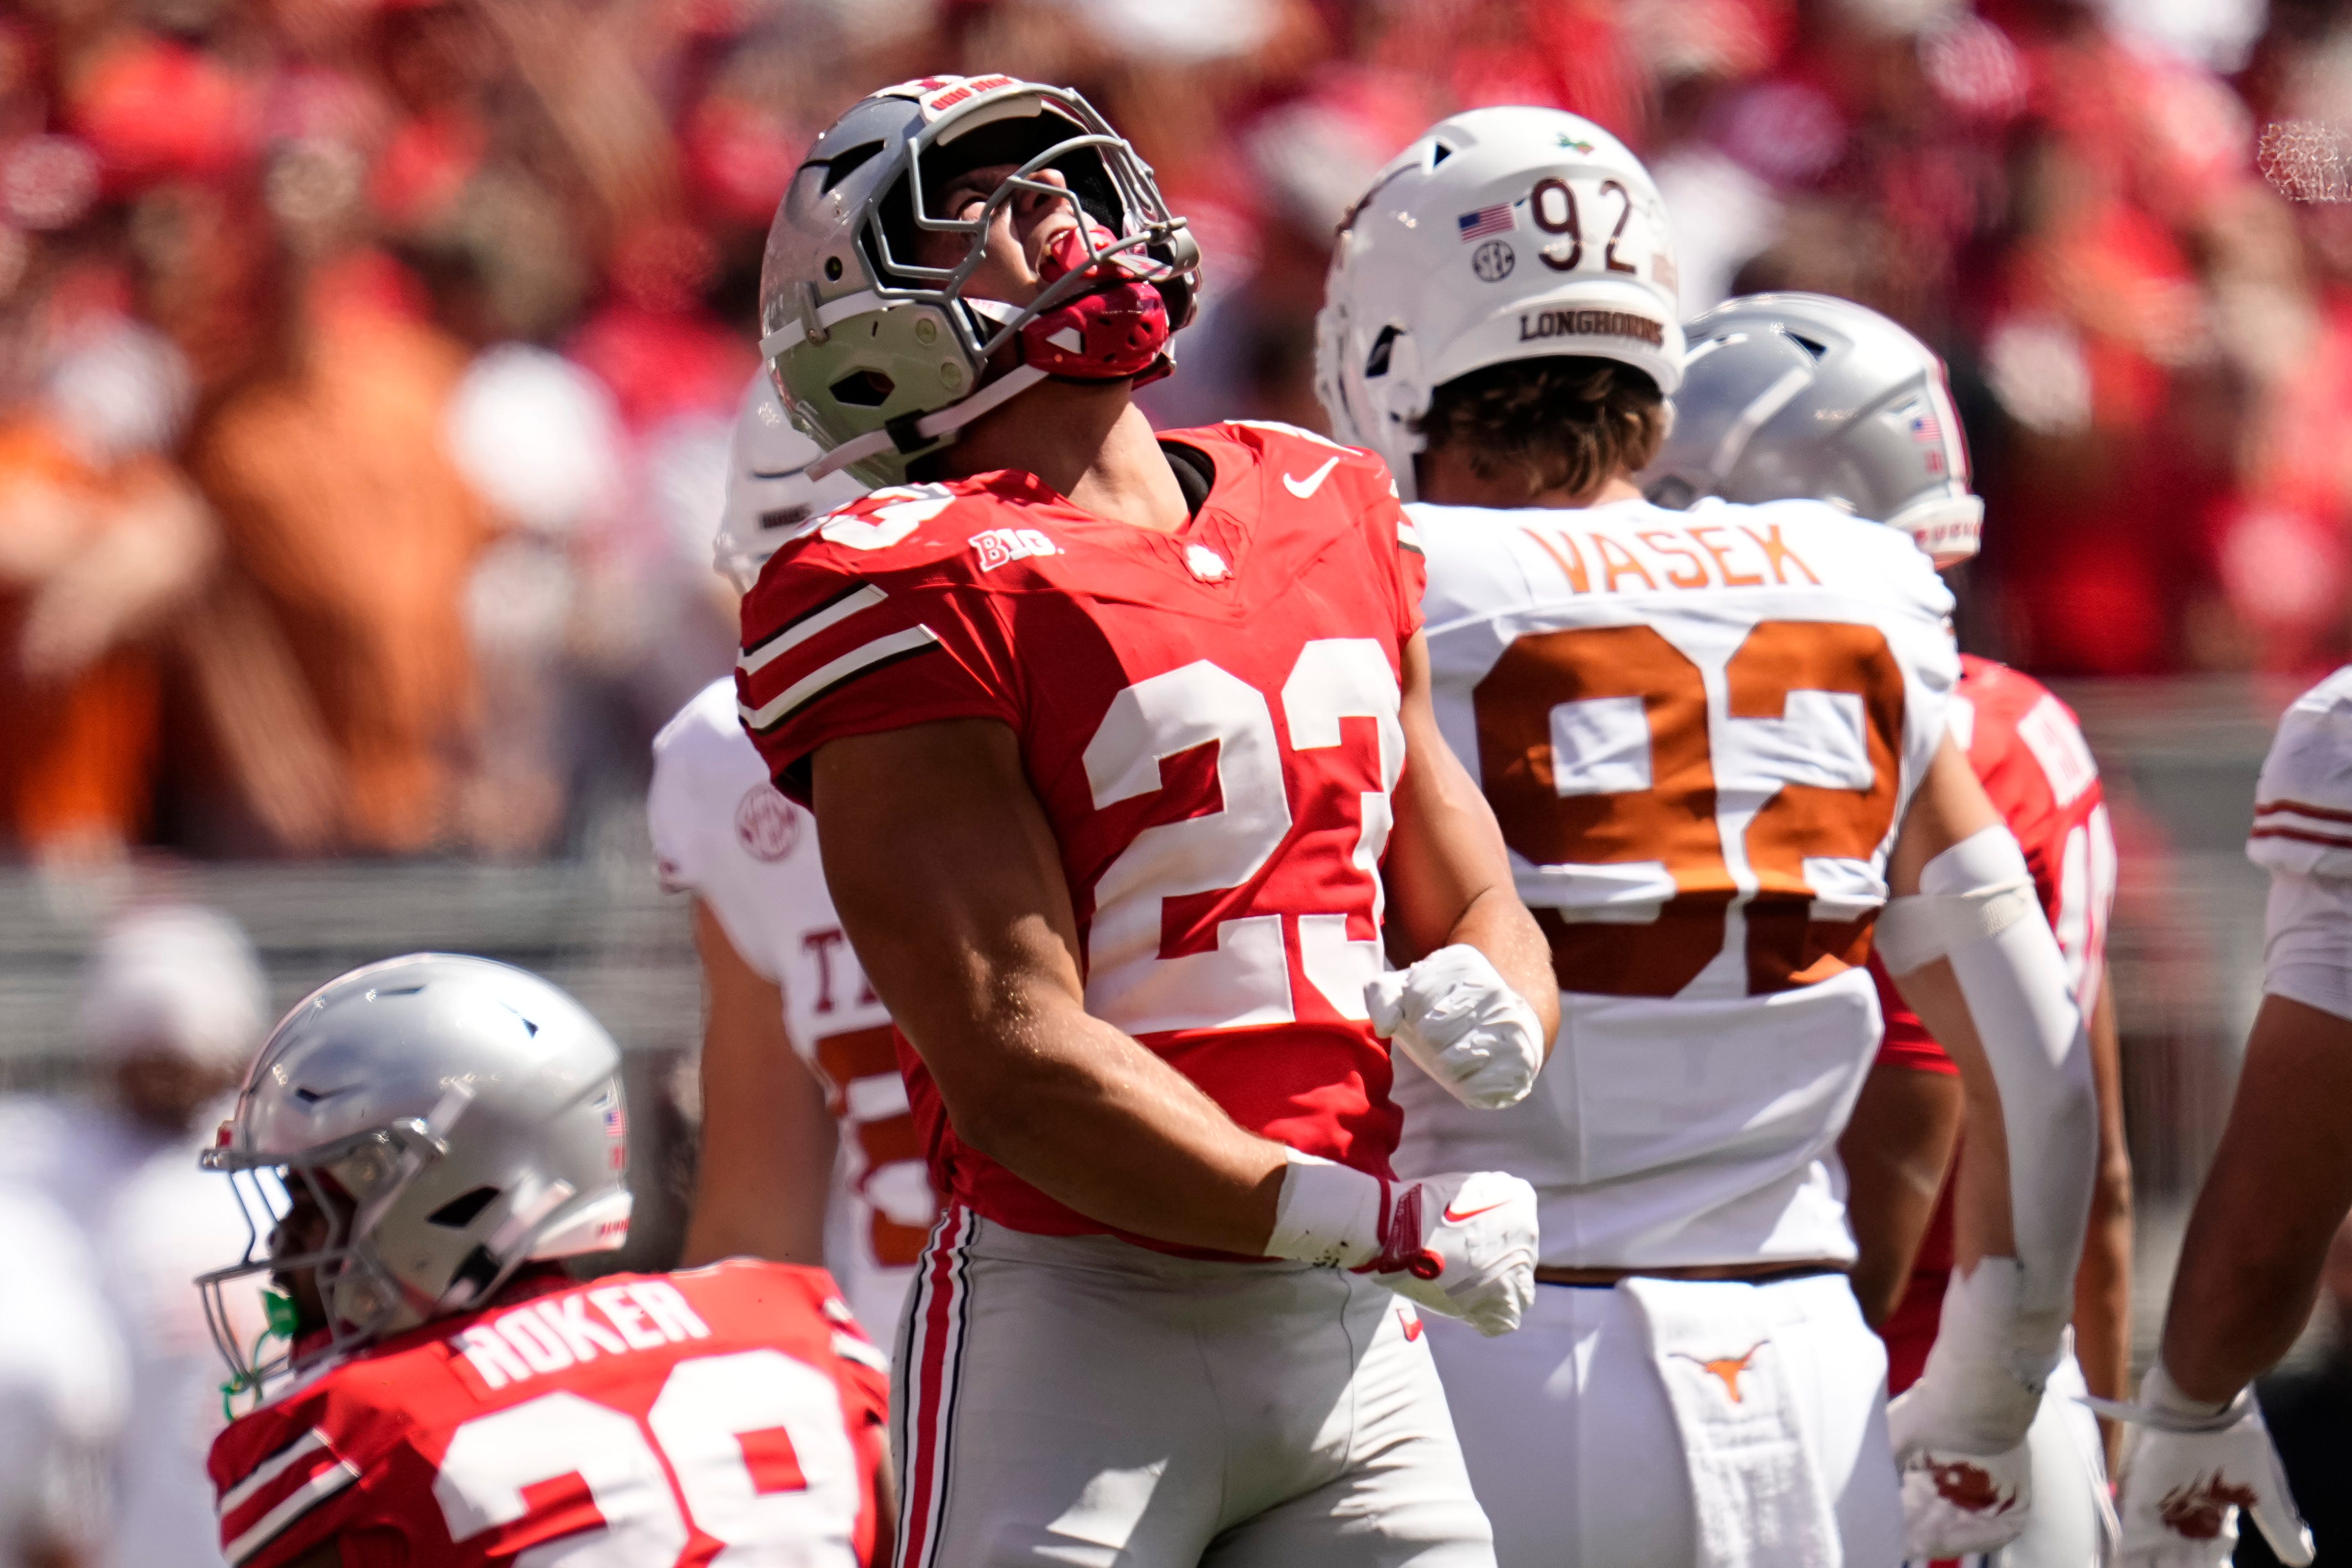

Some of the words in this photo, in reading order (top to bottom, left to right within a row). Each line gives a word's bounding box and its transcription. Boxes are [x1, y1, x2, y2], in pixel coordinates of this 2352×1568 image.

[1531, 177, 1637, 274] 92
[1519, 524, 1824, 595] VASEK
[1082, 638, 1406, 1035] 23
[1472, 619, 1907, 999] 92
[450, 1279, 712, 1391] ROKER
[432, 1348, 860, 1568] 28
